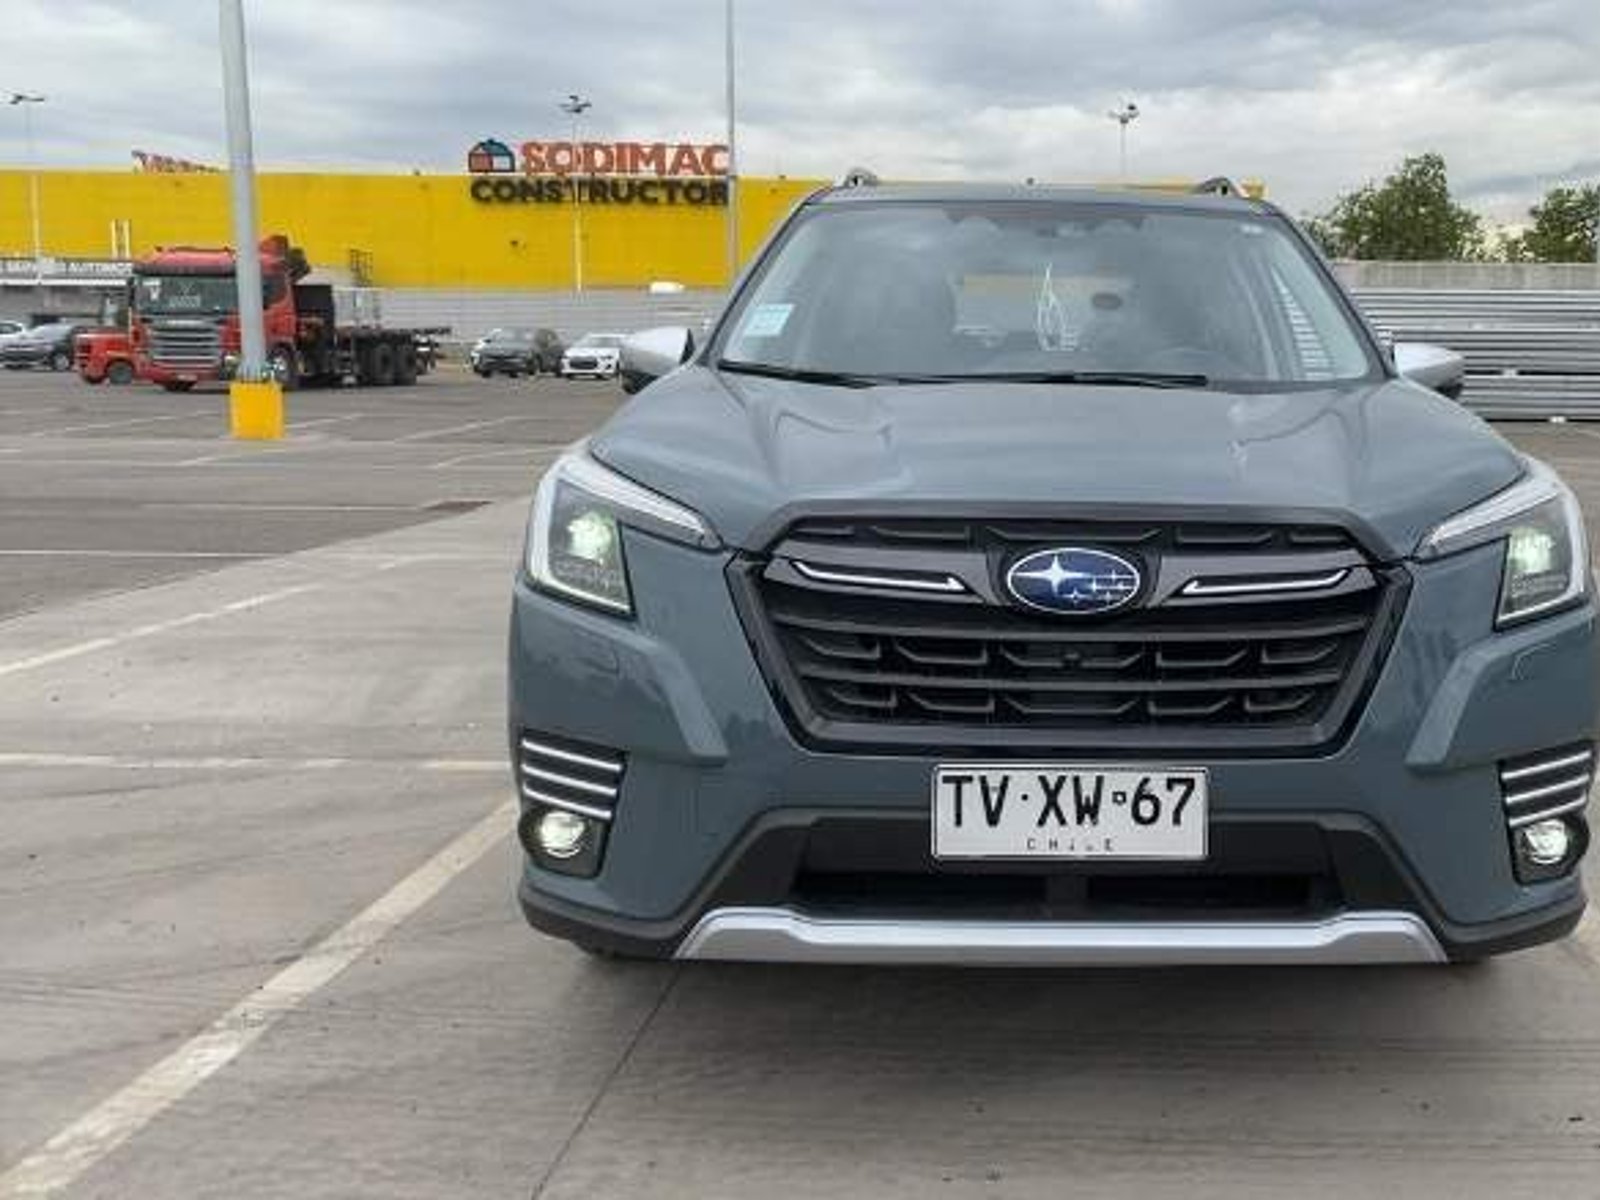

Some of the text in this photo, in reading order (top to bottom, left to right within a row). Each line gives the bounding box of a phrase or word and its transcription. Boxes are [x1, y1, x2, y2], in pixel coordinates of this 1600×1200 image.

[521, 141, 729, 174] SODIMAC
[471, 178, 729, 205] CONSTRUCTOR
[1026, 837, 1115, 851] CHIE
